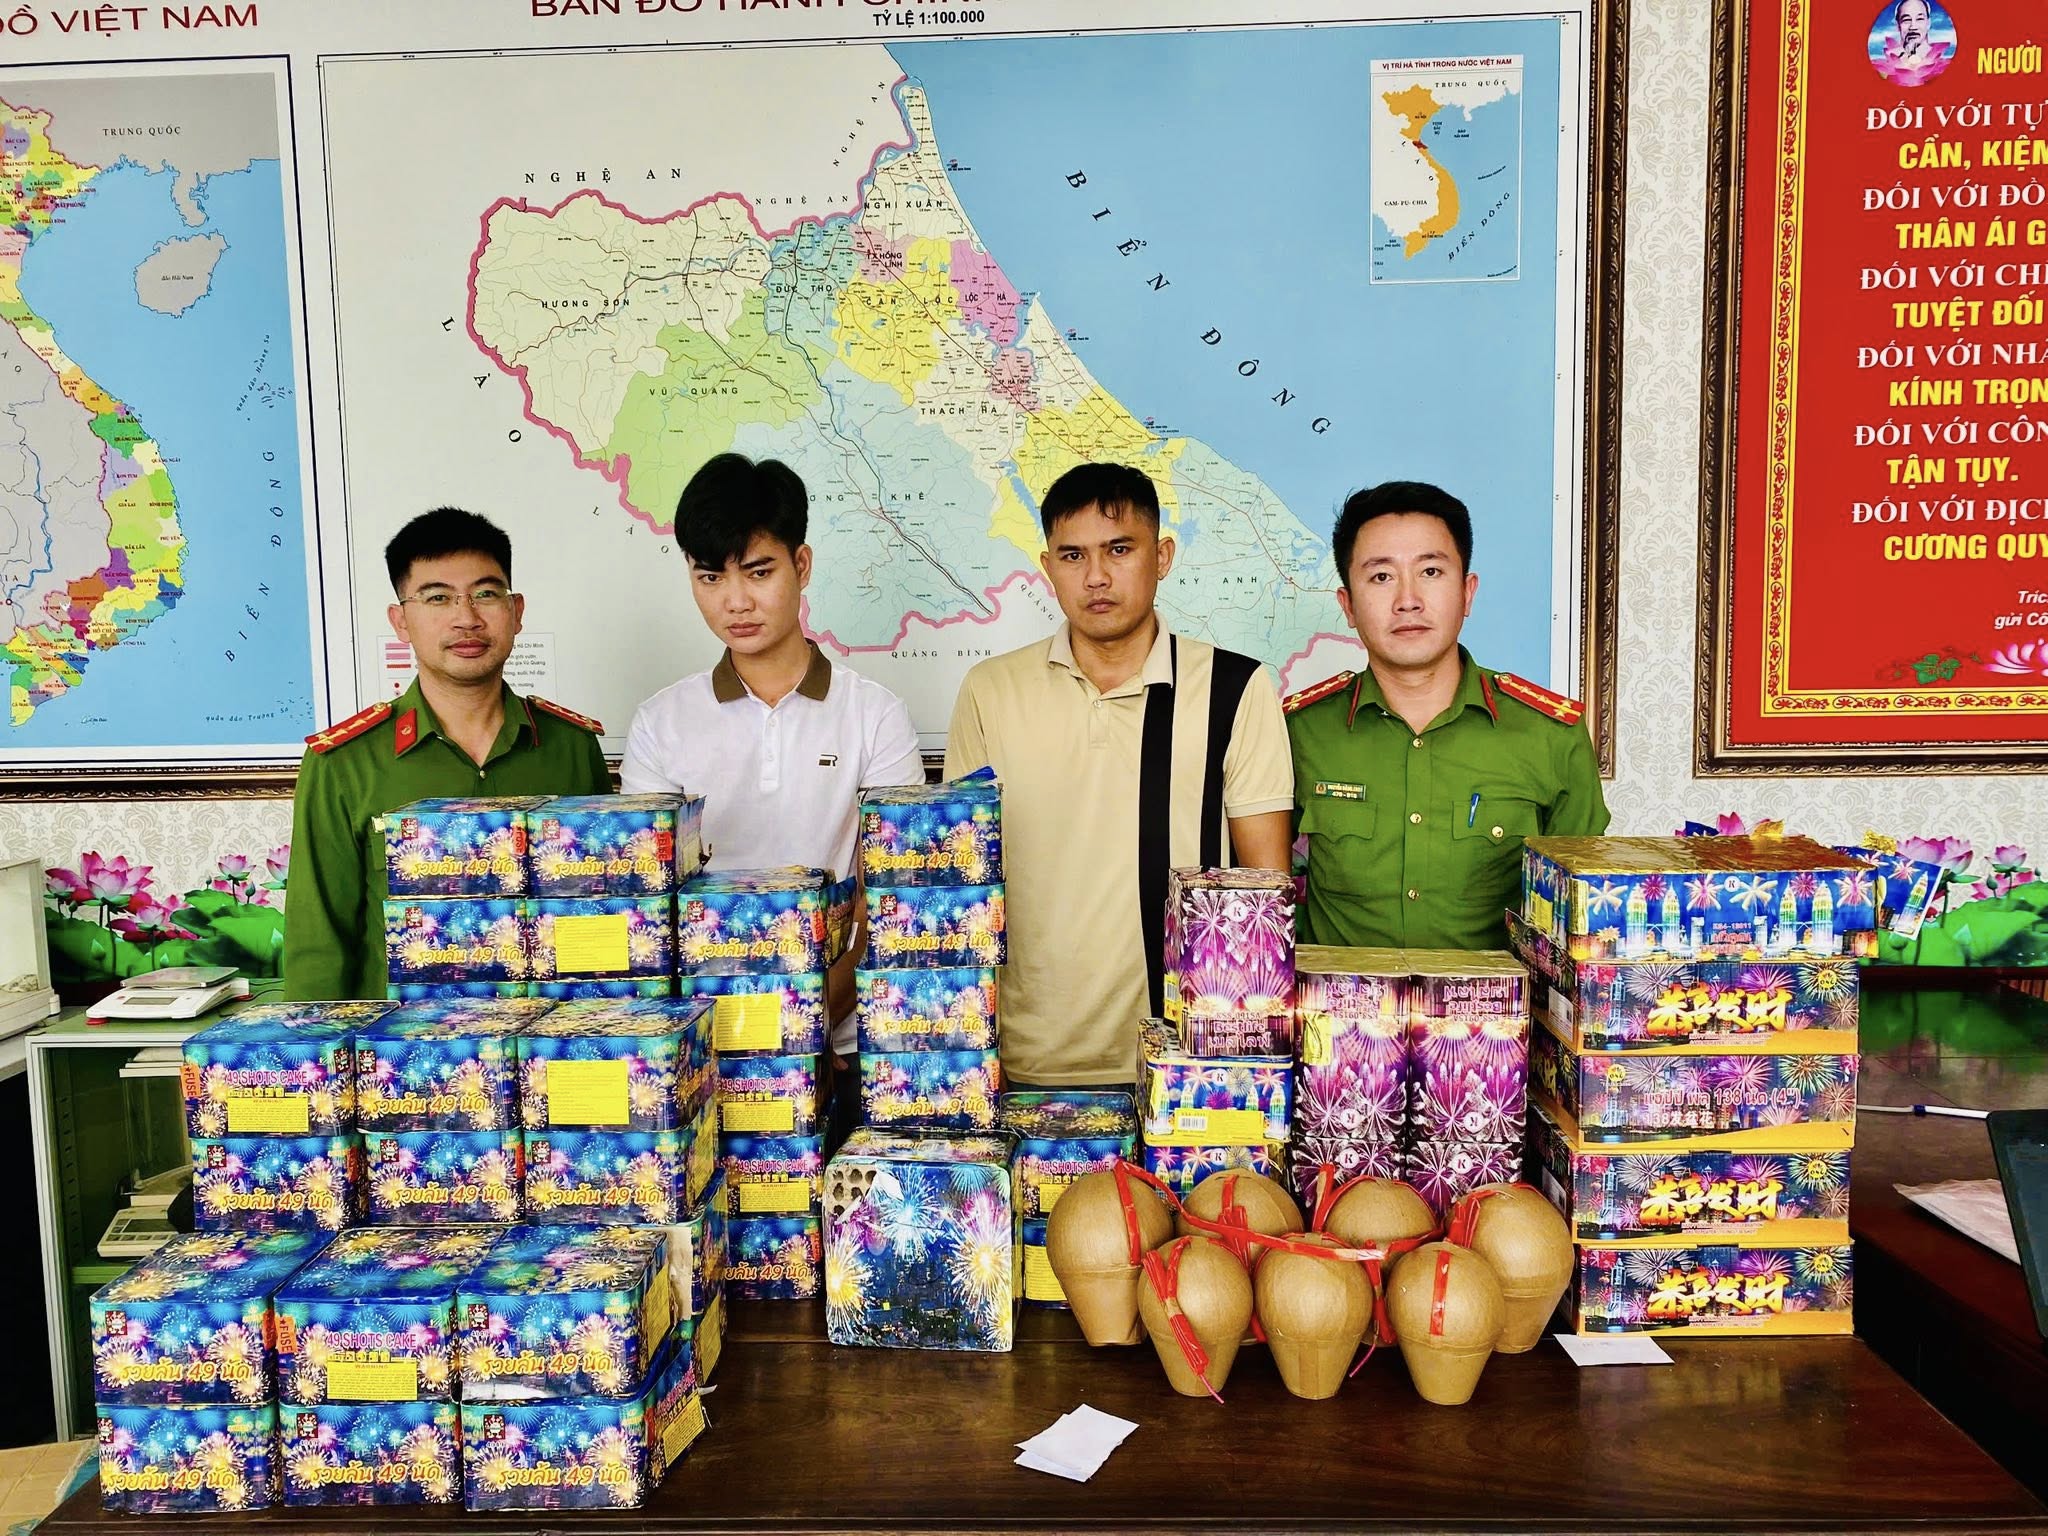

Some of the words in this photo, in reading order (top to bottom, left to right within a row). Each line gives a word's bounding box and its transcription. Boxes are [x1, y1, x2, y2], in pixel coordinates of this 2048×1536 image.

[0, 5, 38, 35] Ồ
[51, 4, 147, 37] VIỆT
[162, 4, 258, 29] NAM
[873, 10, 892, 26] TỶ
[896, 10, 914, 28] LỆ
[919, 10, 985, 25] 1:100.000
[1496, 58, 1512, 66] NAM
[1977, 41, 2042, 74] NGƯỜI
[1866, 100, 1923, 130] ĐỐI
[1934, 98, 1992, 127] VỚI
[103, 128, 142, 137] TRUNG
[148, 125, 181, 136] QUỐC
[1899, 134, 1972, 171] CẦN,
[525, 168, 611, 183] NGHỆ
[646, 168, 682, 180] AN
[756, 196, 807, 205] NGHỆ
[827, 195, 848, 203] AN
[1863, 181, 1920, 211] ĐỐI
[1931, 179, 1989, 208] VỚI
[864, 201, 898, 209] NGHI
[906, 200, 943, 209] XUÂN
[1065, 169, 1171, 292] BIỂN
[1896, 217, 1976, 249] THÂN
[1985, 215, 2016, 247] ÁI
[1860, 262, 1917, 290] ĐỐI
[1928, 259, 1985, 288] VỚI
[811, 285, 833, 293] THỌ
[965, 293, 979, 303] LỘC
[541, 299, 589, 309] HƯƠNG
[603, 298, 630, 307] SƠN
[1892, 296, 1984, 333] TUYỆT
[1992, 290, 2044, 326] ĐỐI
[1857, 339, 1914, 369] ĐỐI
[1924, 337, 1982, 367] VỚI
[1200, 326, 1332, 435] ĐÔNG
[649, 386, 668, 396] VŨ
[690, 387, 739, 397] QUANG
[1889, 375, 1963, 407] KÍNH
[1854, 418, 1912, 447] ĐỐI
[1921, 416, 1979, 445] VỚI
[1886, 453, 1945, 489] TẬN
[1955, 457, 2019, 488] TỤY.
[809, 493, 844, 502] ƠNG
[891, 491, 925, 500] KHÊ
[1851, 496, 1908, 524] ĐỐI
[1918, 494, 1976, 522] VỚI
[1984, 498, 2048, 526] ĐỊC
[1884, 533, 1987, 561] CƯƠNG
[1223, 576, 1257, 584] ANH
[1994, 612, 2022, 630] gửi
[891, 649, 938, 659] QUẢNG
[957, 648, 992, 657] BÌNH
[466, 858, 488, 875] 49
[928, 852, 950, 868] 49
[1449, 1000, 1502, 1013] Bestlife
[1214, 1020, 1265, 1034] Bestlife
[184, 1072, 197, 1098] FUSE
[241, 1070, 278, 1086] SHOTS
[280, 1070, 308, 1085] CAKE
[1714, 1088, 1741, 1106] 138
[279, 1192, 303, 1211] 49
[605, 1187, 630, 1204] 49
[280, 1325, 293, 1352] FUSE
[344, 1332, 383, 1349] SHOTS
[385, 1332, 416, 1349] CAKE
[188, 1361, 216, 1381] 49
[566, 1467, 594, 1485] 49
